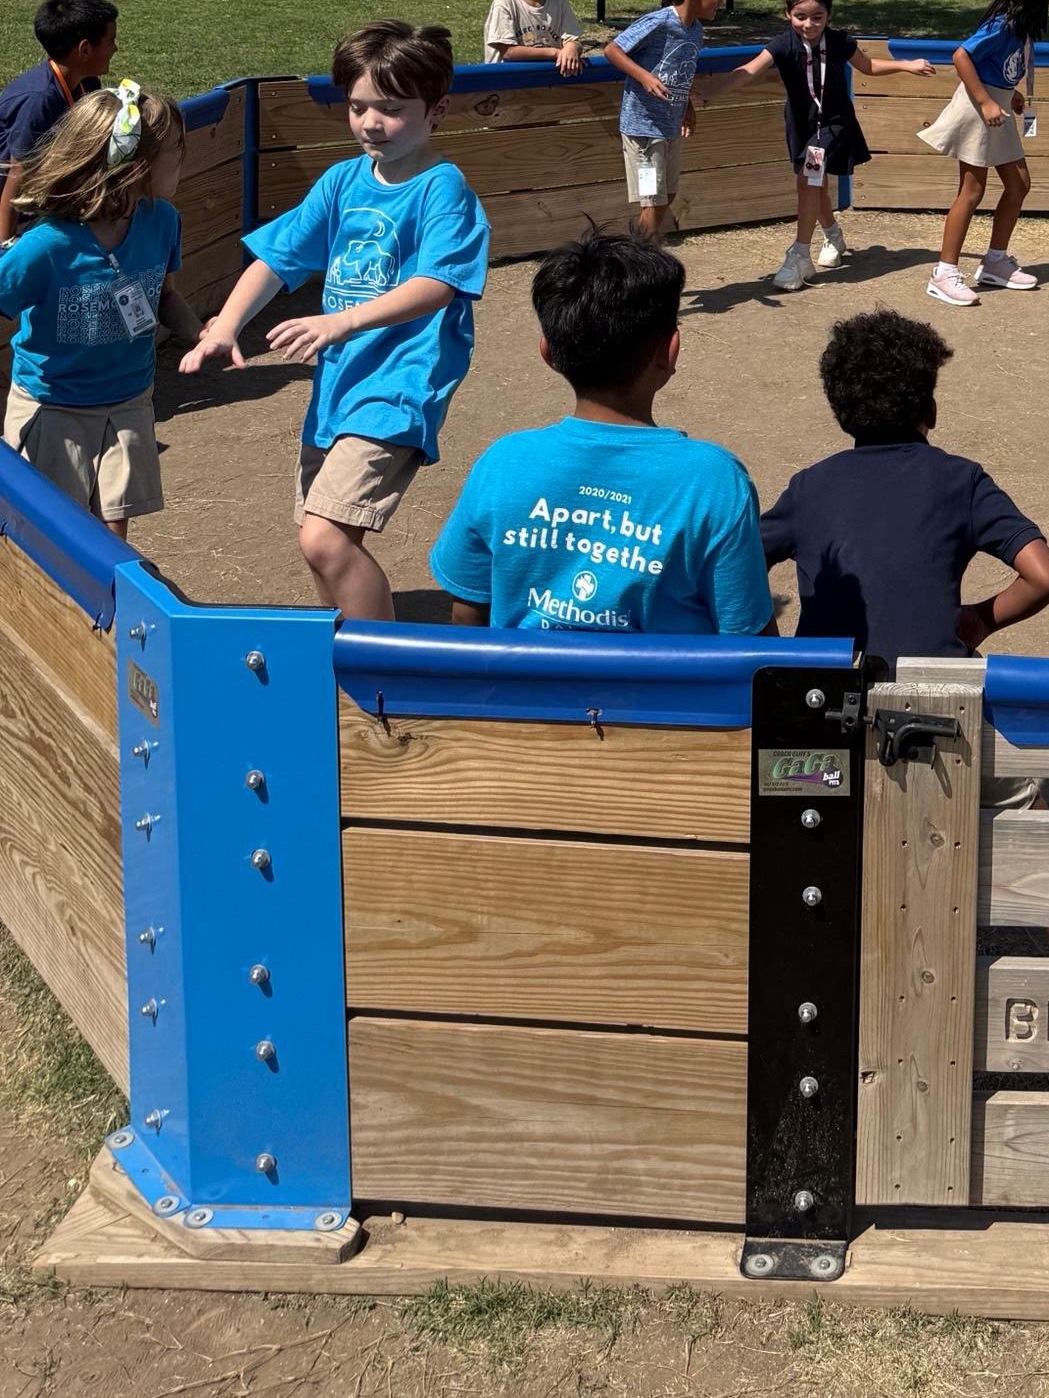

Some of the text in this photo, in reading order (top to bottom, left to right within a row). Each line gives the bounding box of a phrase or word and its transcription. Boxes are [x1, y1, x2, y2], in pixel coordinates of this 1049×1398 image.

[578, 485, 632, 505] 2020/2021
[528, 497, 663, 545] Apart, but
[502, 527, 559, 549] still
[527, 587, 631, 628] Methodis
[822, 770, 841, 781] ball
